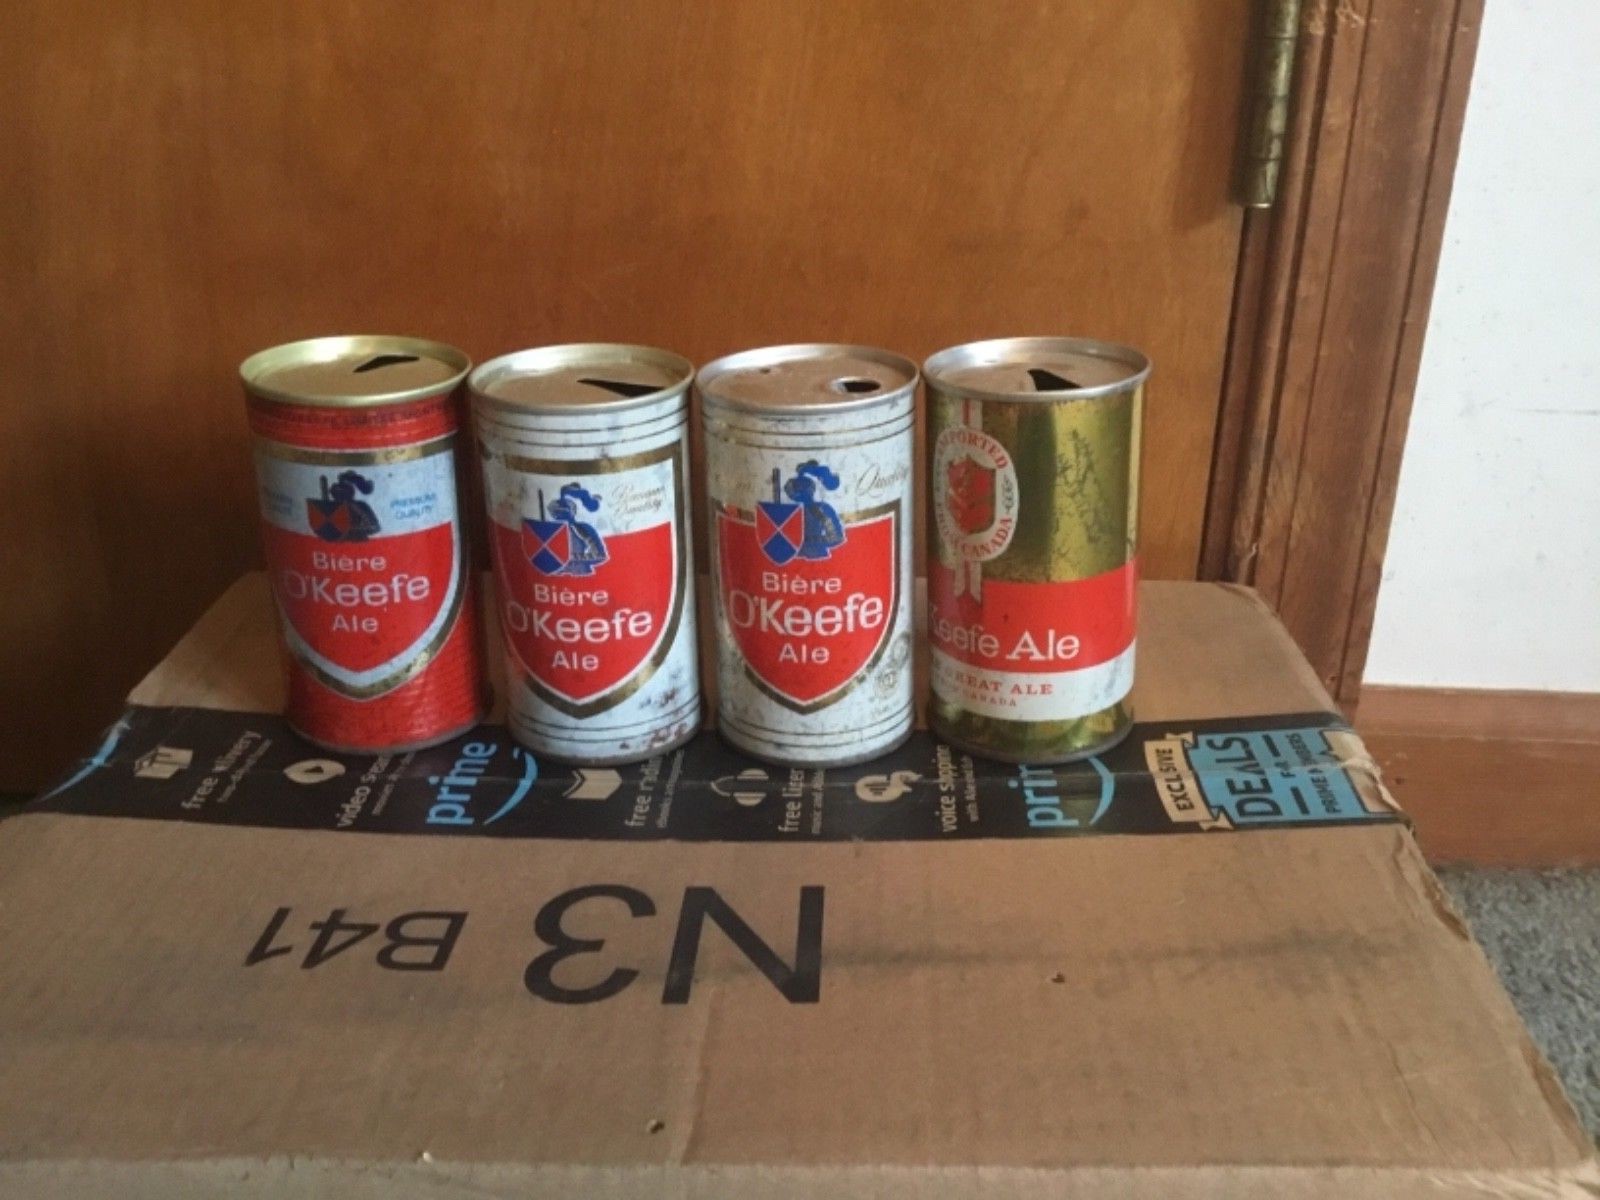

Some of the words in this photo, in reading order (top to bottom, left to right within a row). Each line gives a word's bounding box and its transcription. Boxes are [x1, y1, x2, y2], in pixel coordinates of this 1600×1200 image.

[312, 551, 387, 572] Bière
[284, 573, 431, 607] O'Keefe
[534, 583, 609, 608] Bière
[761, 571, 842, 595] Bière
[333, 615, 379, 633] Ale
[506, 600, 653, 645] O'Keefe
[729, 592, 884, 637] O'Keefe
[551, 651, 600, 671] Ale
[778, 643, 830, 665] Ale
[1005, 628, 1080, 661] Ale
[1010, 683, 1054, 696] ALE
[181, 777, 219, 809] free
[425, 741, 497, 827] prime
[1206, 736, 1282, 817] DEALS
[334, 785, 372, 827] video
[623, 794, 653, 828] free
[1310, 776, 1343, 814] PRIME
[776, 801, 803, 833] free
[934, 795, 958, 833] voice
[243, 906, 469, 972] B41
[524, 884, 825, 1006] N3
